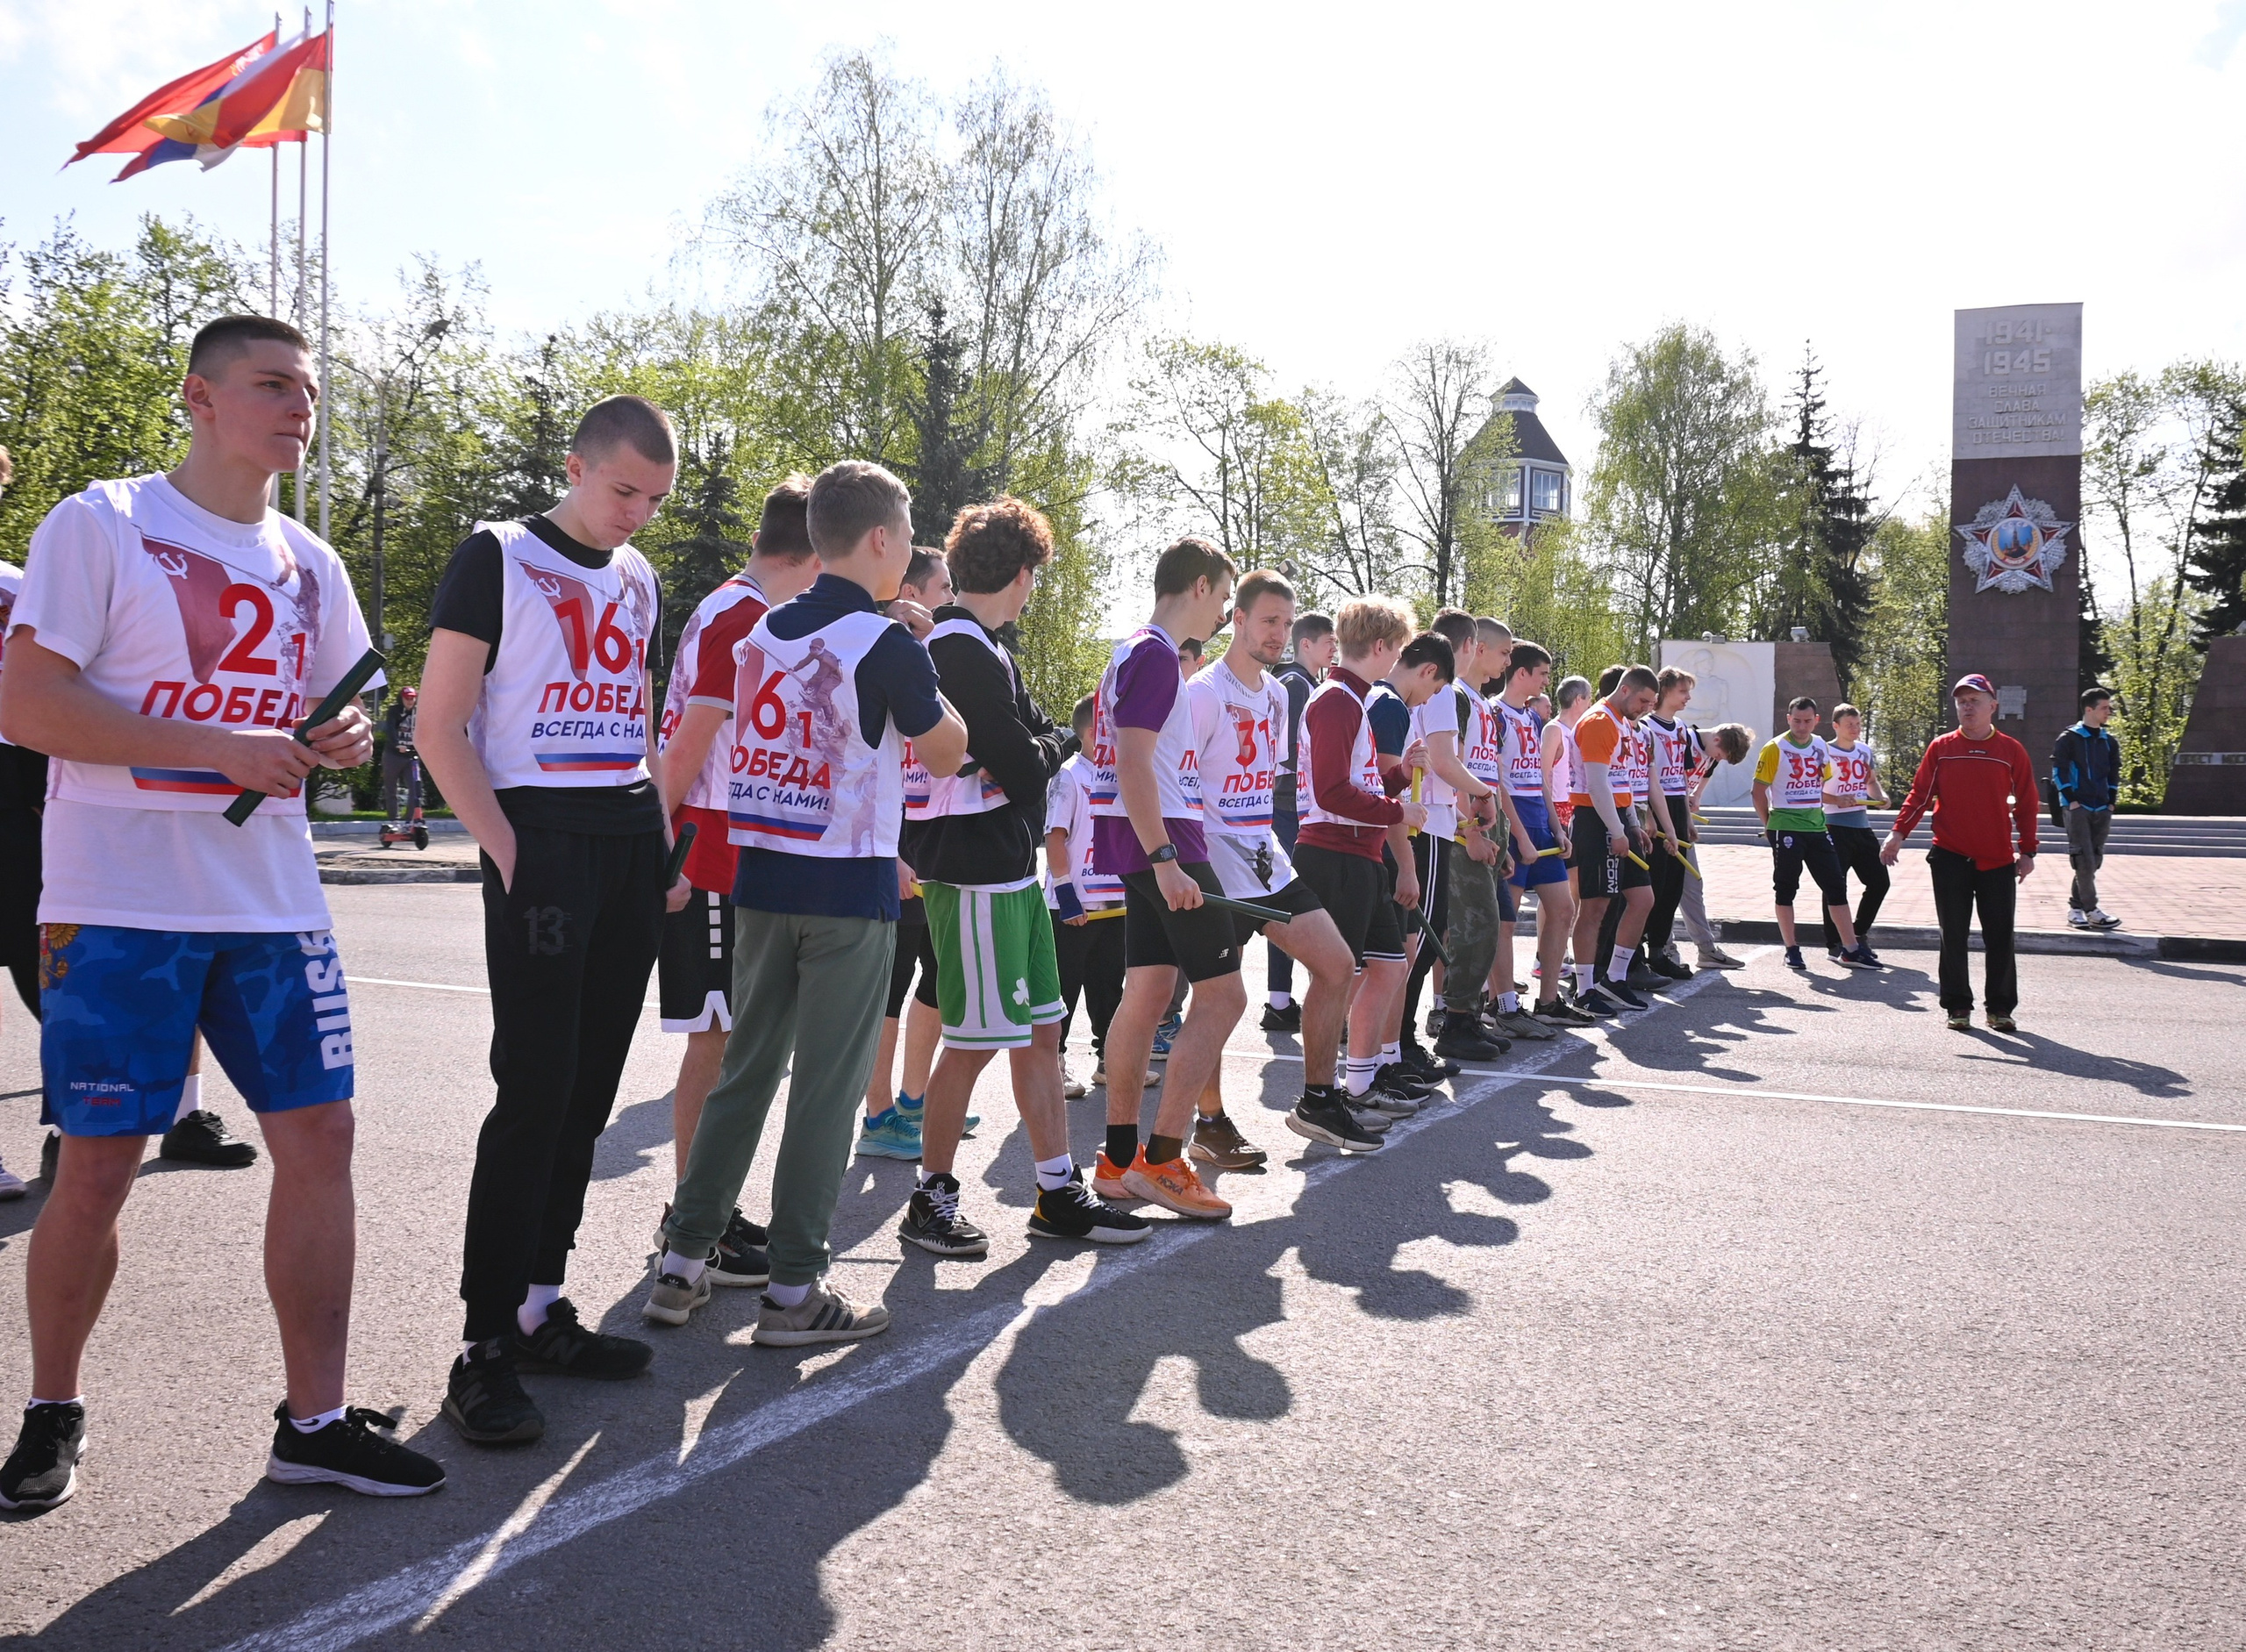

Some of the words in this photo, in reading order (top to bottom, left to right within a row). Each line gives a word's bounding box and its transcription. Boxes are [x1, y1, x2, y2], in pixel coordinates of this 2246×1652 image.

[1984, 349, 2051, 375] 1945
[1989, 384, 2046, 398] ВЕЧНАЯ
[1994, 399, 2041, 413] СЛАВА
[1968, 413, 2066, 429] ЗАЩИТНИКАМ
[218, 583, 276, 676] 2
[292, 633, 306, 680] 1
[554, 597, 633, 675] 16
[752, 670, 788, 740] 6
[798, 712, 812, 748] 1
[531, 720, 604, 740] ВСЕГДА
[610, 722, 621, 736] С
[1235, 718, 1270, 768] 31
[729, 745, 831, 790] ОБЕДА
[1789, 758, 1819, 779] 35
[1836, 760, 1865, 782] 30
[756, 786, 770, 800] С
[773, 789, 830, 811] НАМИ!
[1218, 795, 1262, 808] ВСЕГДА
[70, 1082, 135, 1092] NATIONAL
[82, 1096, 121, 1106] TEAM
[1156, 1174, 1184, 1195] HOKA
